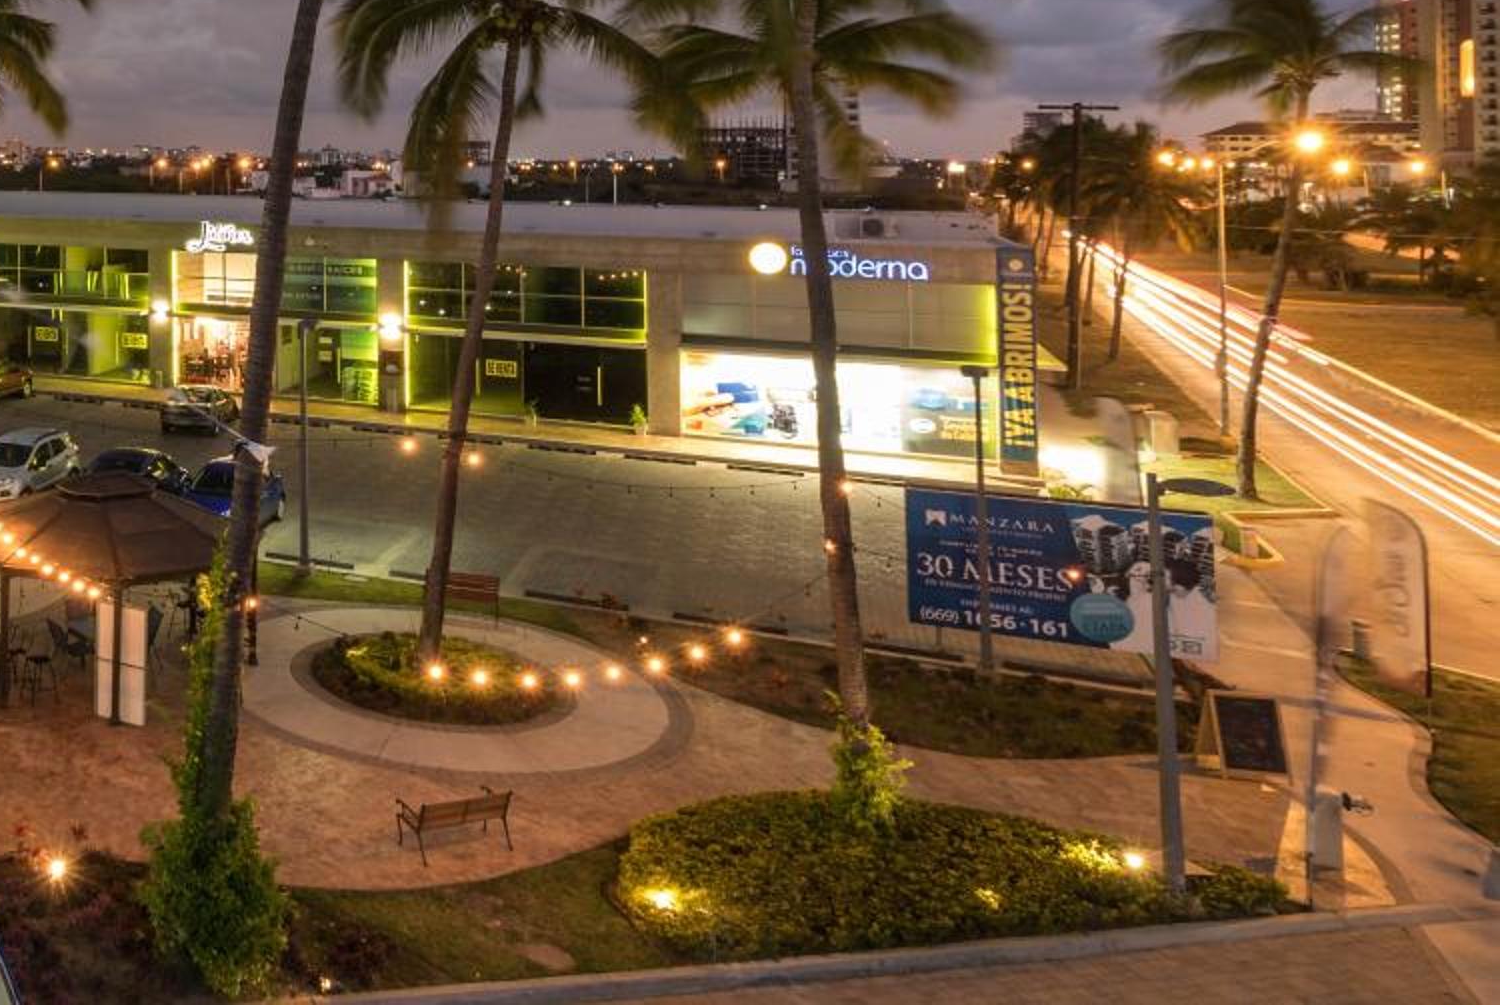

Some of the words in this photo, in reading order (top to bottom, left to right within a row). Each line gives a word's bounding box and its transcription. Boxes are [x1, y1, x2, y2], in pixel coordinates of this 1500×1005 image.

[1002, 283, 1035, 404] ABRIMOS!
[951, 514, 1055, 533] MANZARA
[917, 552, 953, 578] 30
[963, 559, 1074, 592] MESES
[920, 605, 959, 624] (669)
